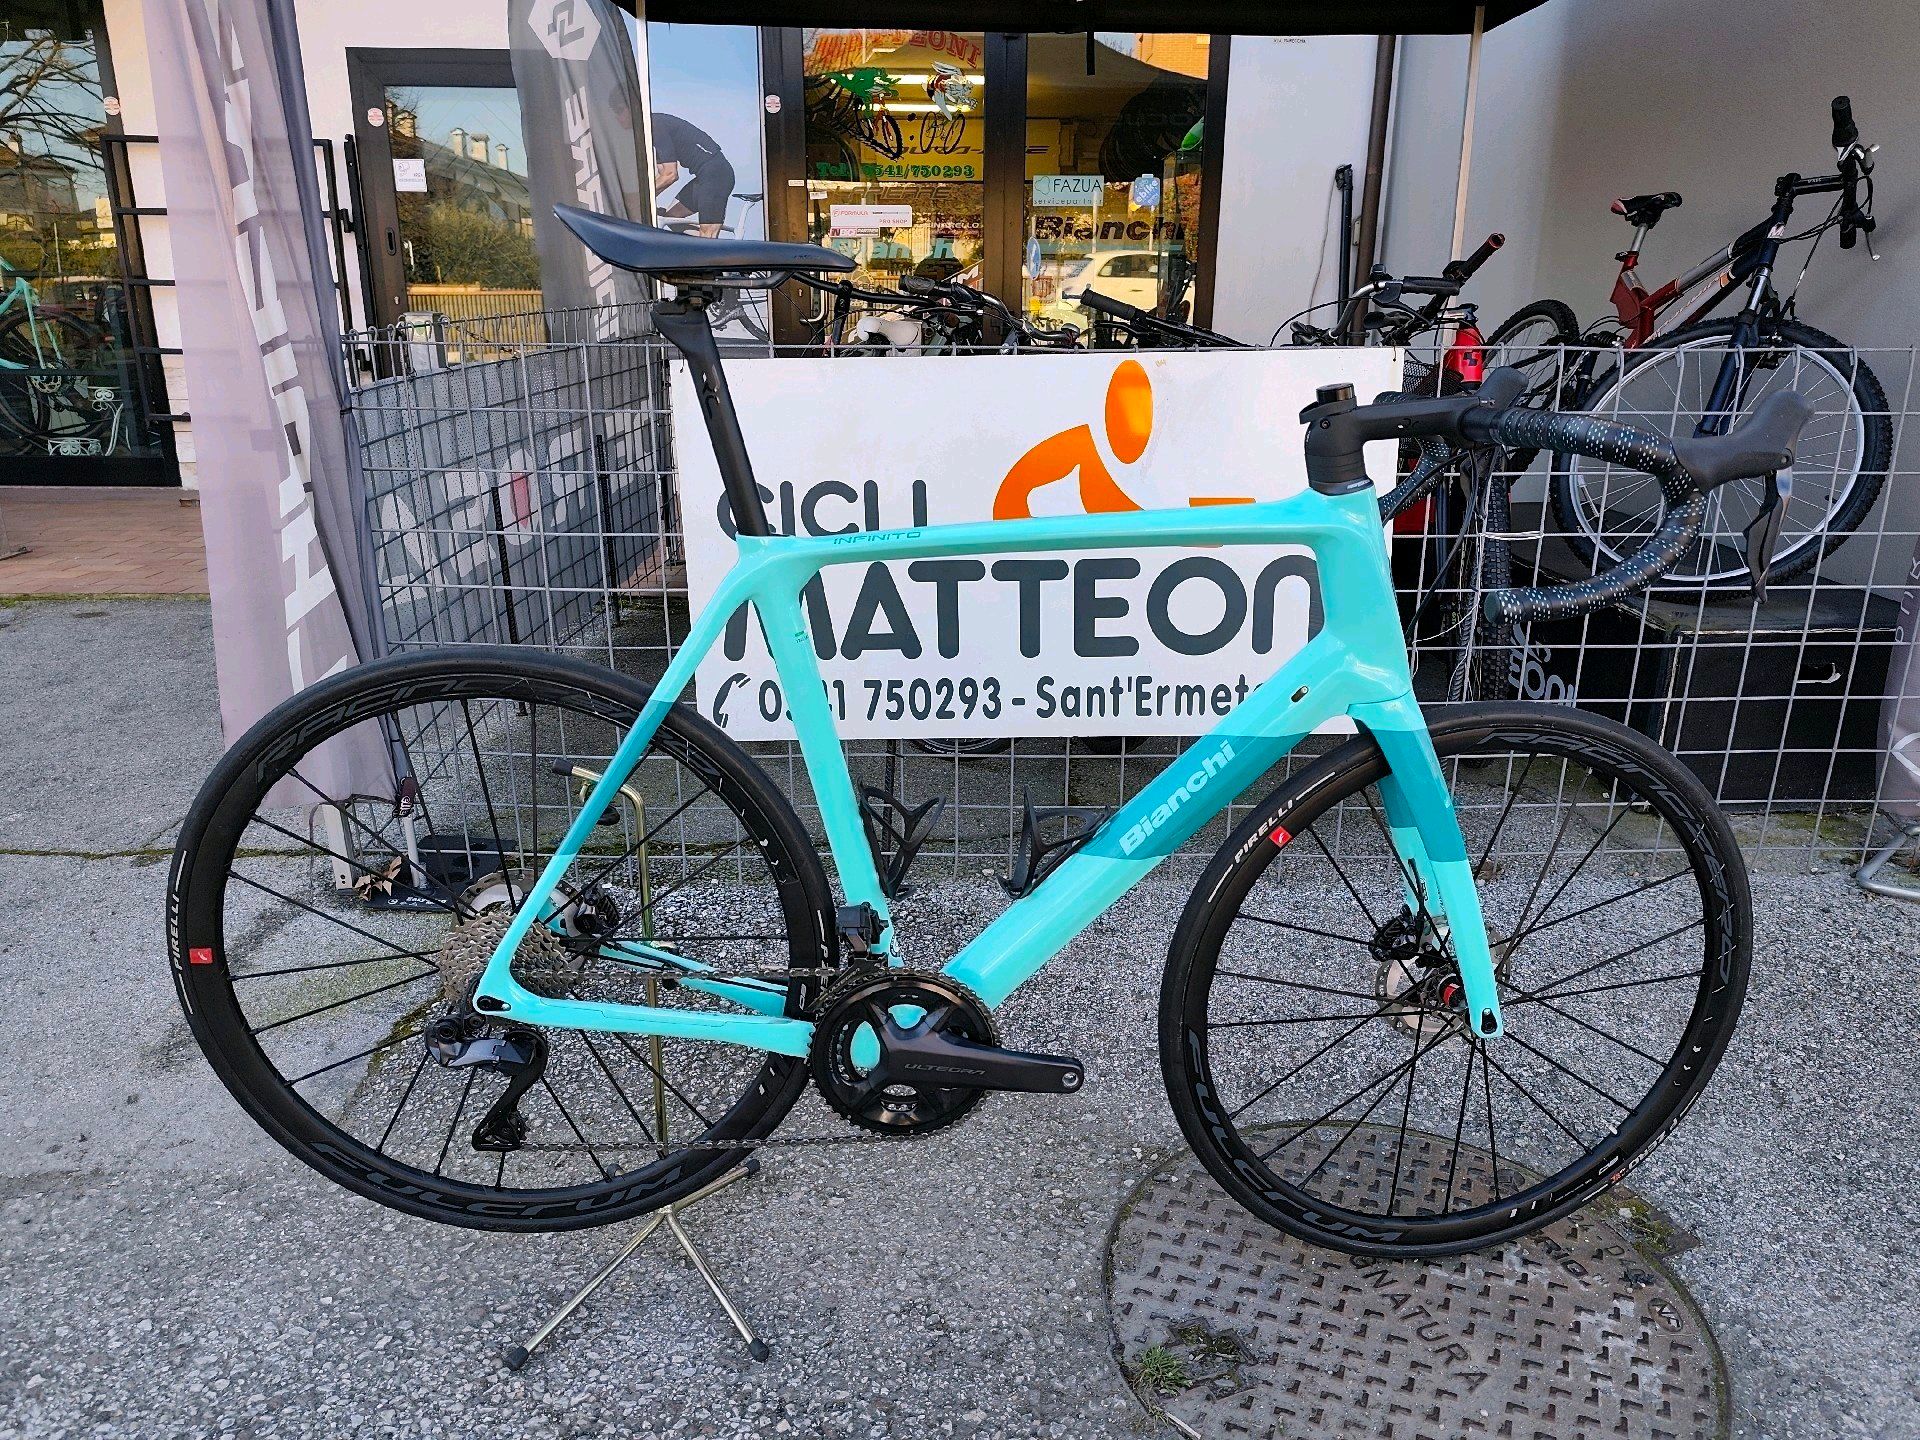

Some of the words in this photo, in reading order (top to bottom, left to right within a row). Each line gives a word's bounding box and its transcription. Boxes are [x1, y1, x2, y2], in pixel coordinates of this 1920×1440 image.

[1053, 178, 1102, 193] FAZUA
[833, 531, 922, 545] INFINITO
[864, 676, 1001, 721] 750293
[1118, 738, 1238, 858] Bianchi
[1234, 799, 1293, 864] PIRELLI
[170, 893, 181, 971] PIRELLI
[904, 1062, 986, 1076] ULTEGRA
